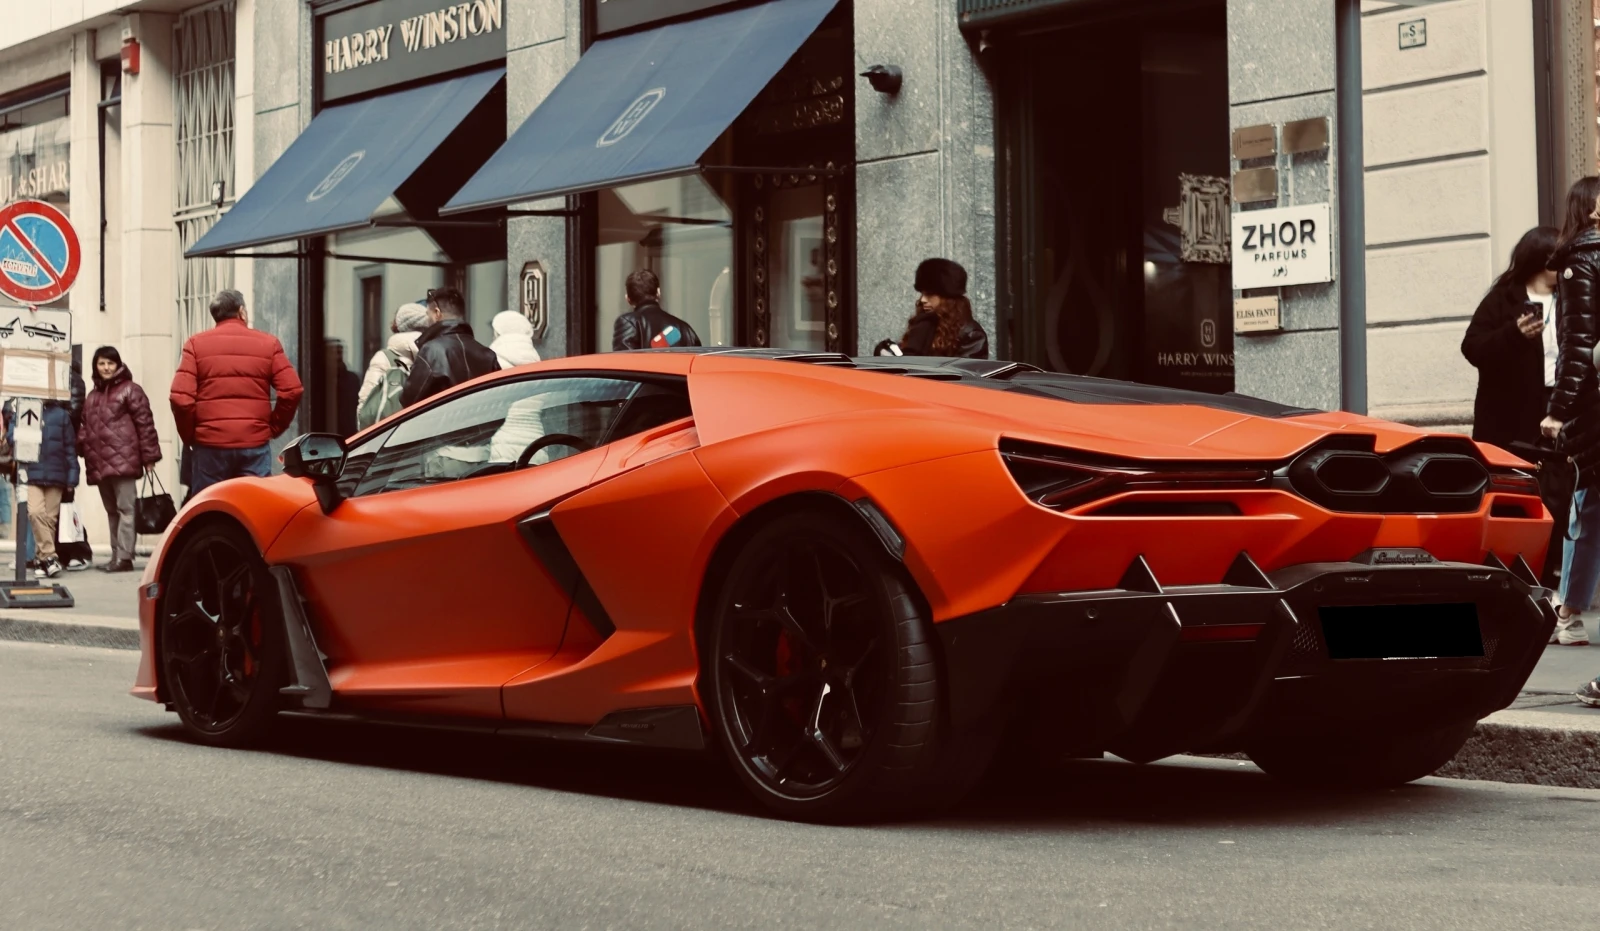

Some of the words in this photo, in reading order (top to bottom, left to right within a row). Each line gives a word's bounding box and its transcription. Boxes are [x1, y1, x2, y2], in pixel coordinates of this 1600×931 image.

[325, 23, 393, 74] HARRY
[400, 0, 502, 53] WINSTON
[18, 175, 27, 196] &
[29, 160, 70, 197] SHAR
[1242, 219, 1316, 250] ZHOR
[1254, 249, 1307, 262] PARFUMS
[1236, 310, 1255, 319] ELISA
[1256, 308, 1276, 317] FANTI
[1158, 352, 1199, 366] HARRY
